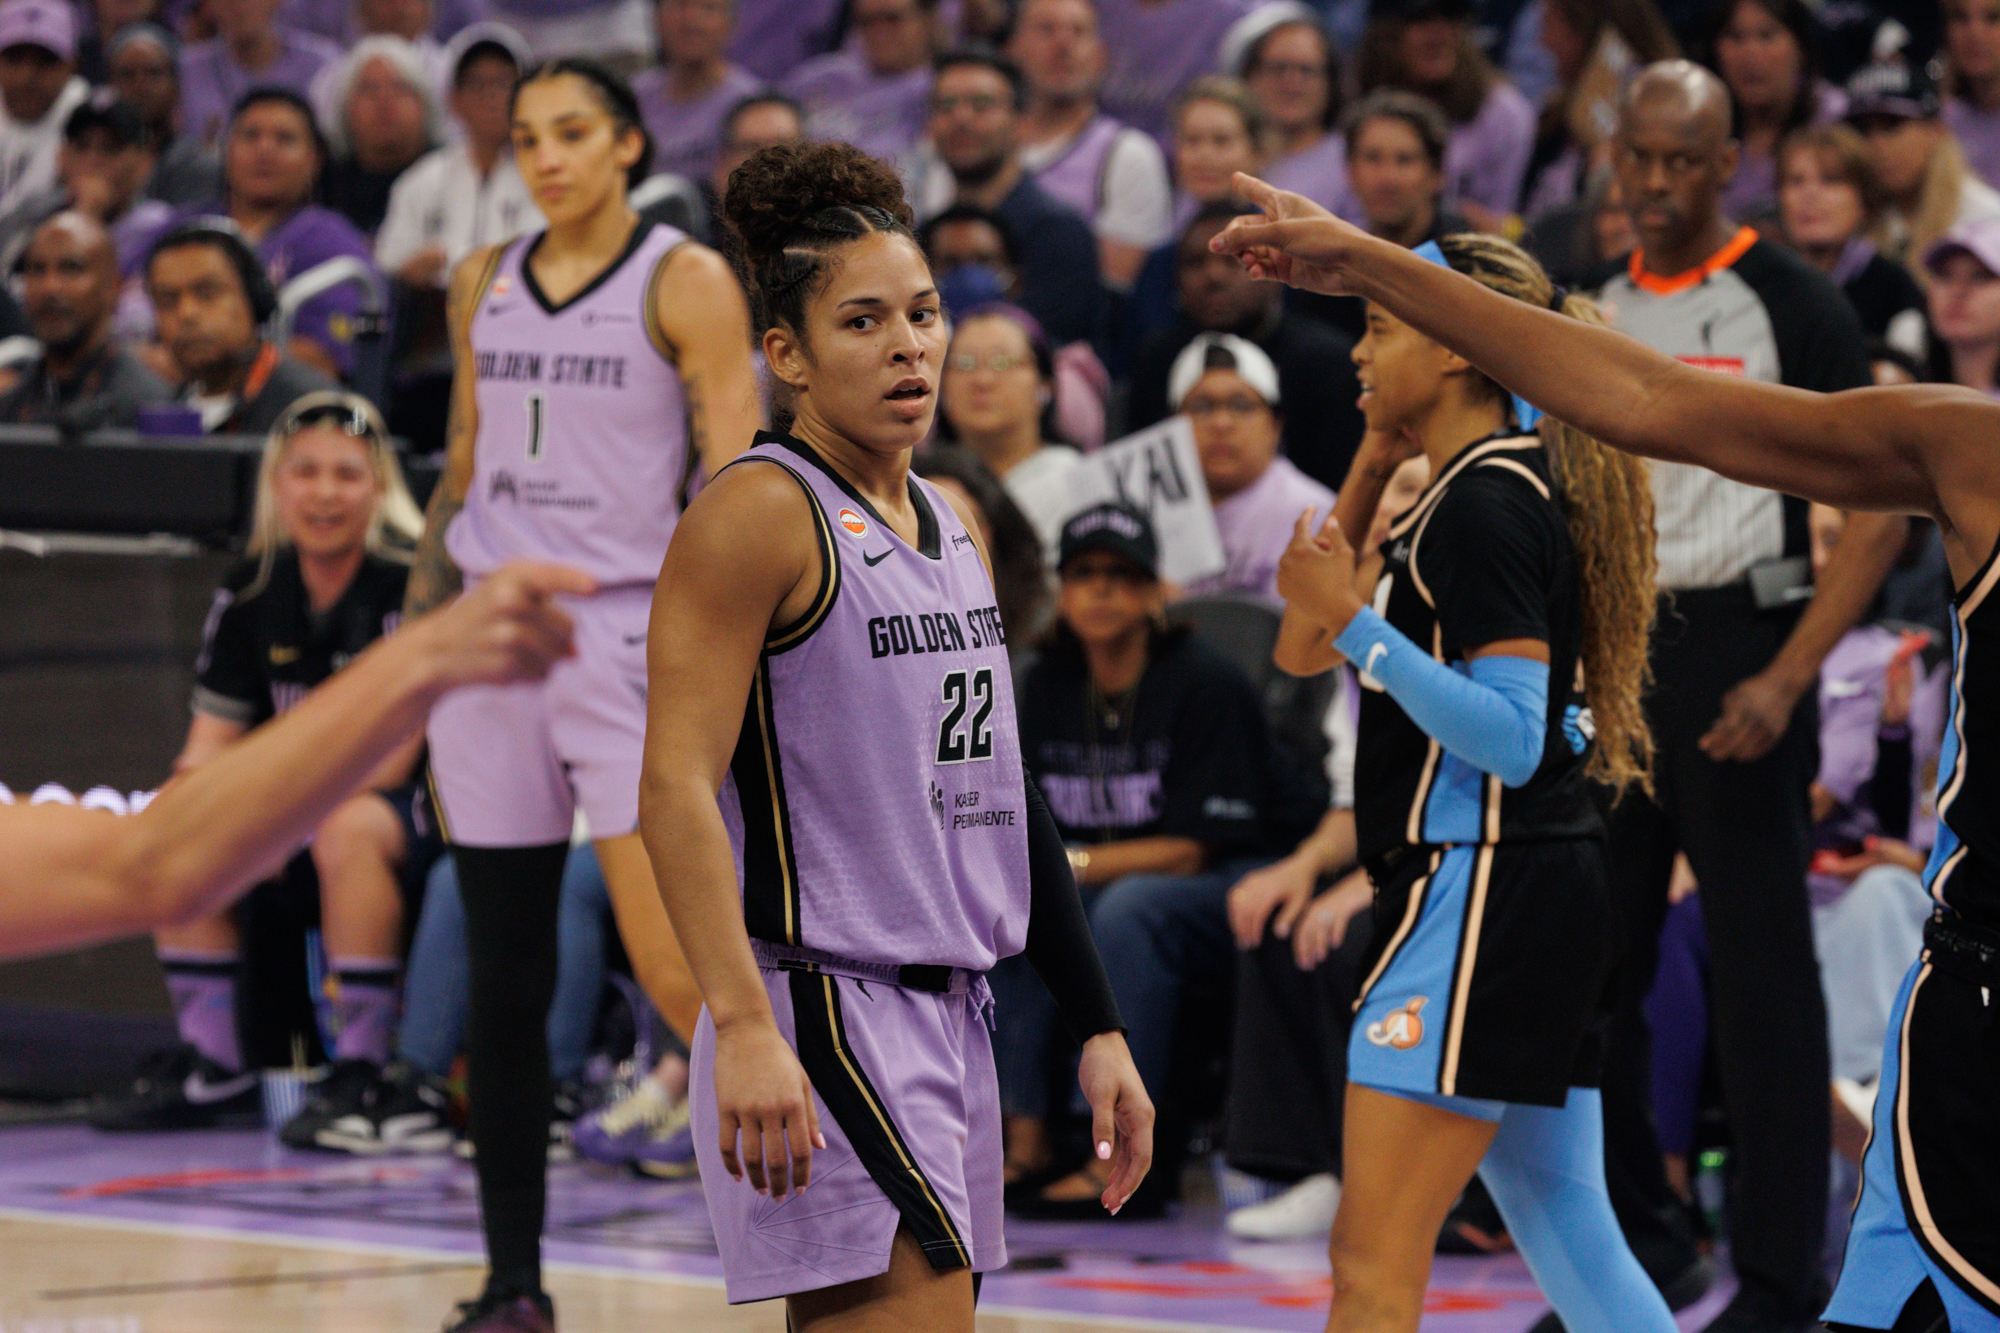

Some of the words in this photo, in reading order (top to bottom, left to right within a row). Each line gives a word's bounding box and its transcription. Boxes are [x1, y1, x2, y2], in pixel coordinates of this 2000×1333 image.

[550, 354, 626, 389] STATE
[525, 391, 547, 463] 1
[868, 612, 966, 659] GOLDEN
[966, 605, 1007, 649] STAE
[934, 666, 995, 765] 22
[955, 791, 980, 808] KASER
